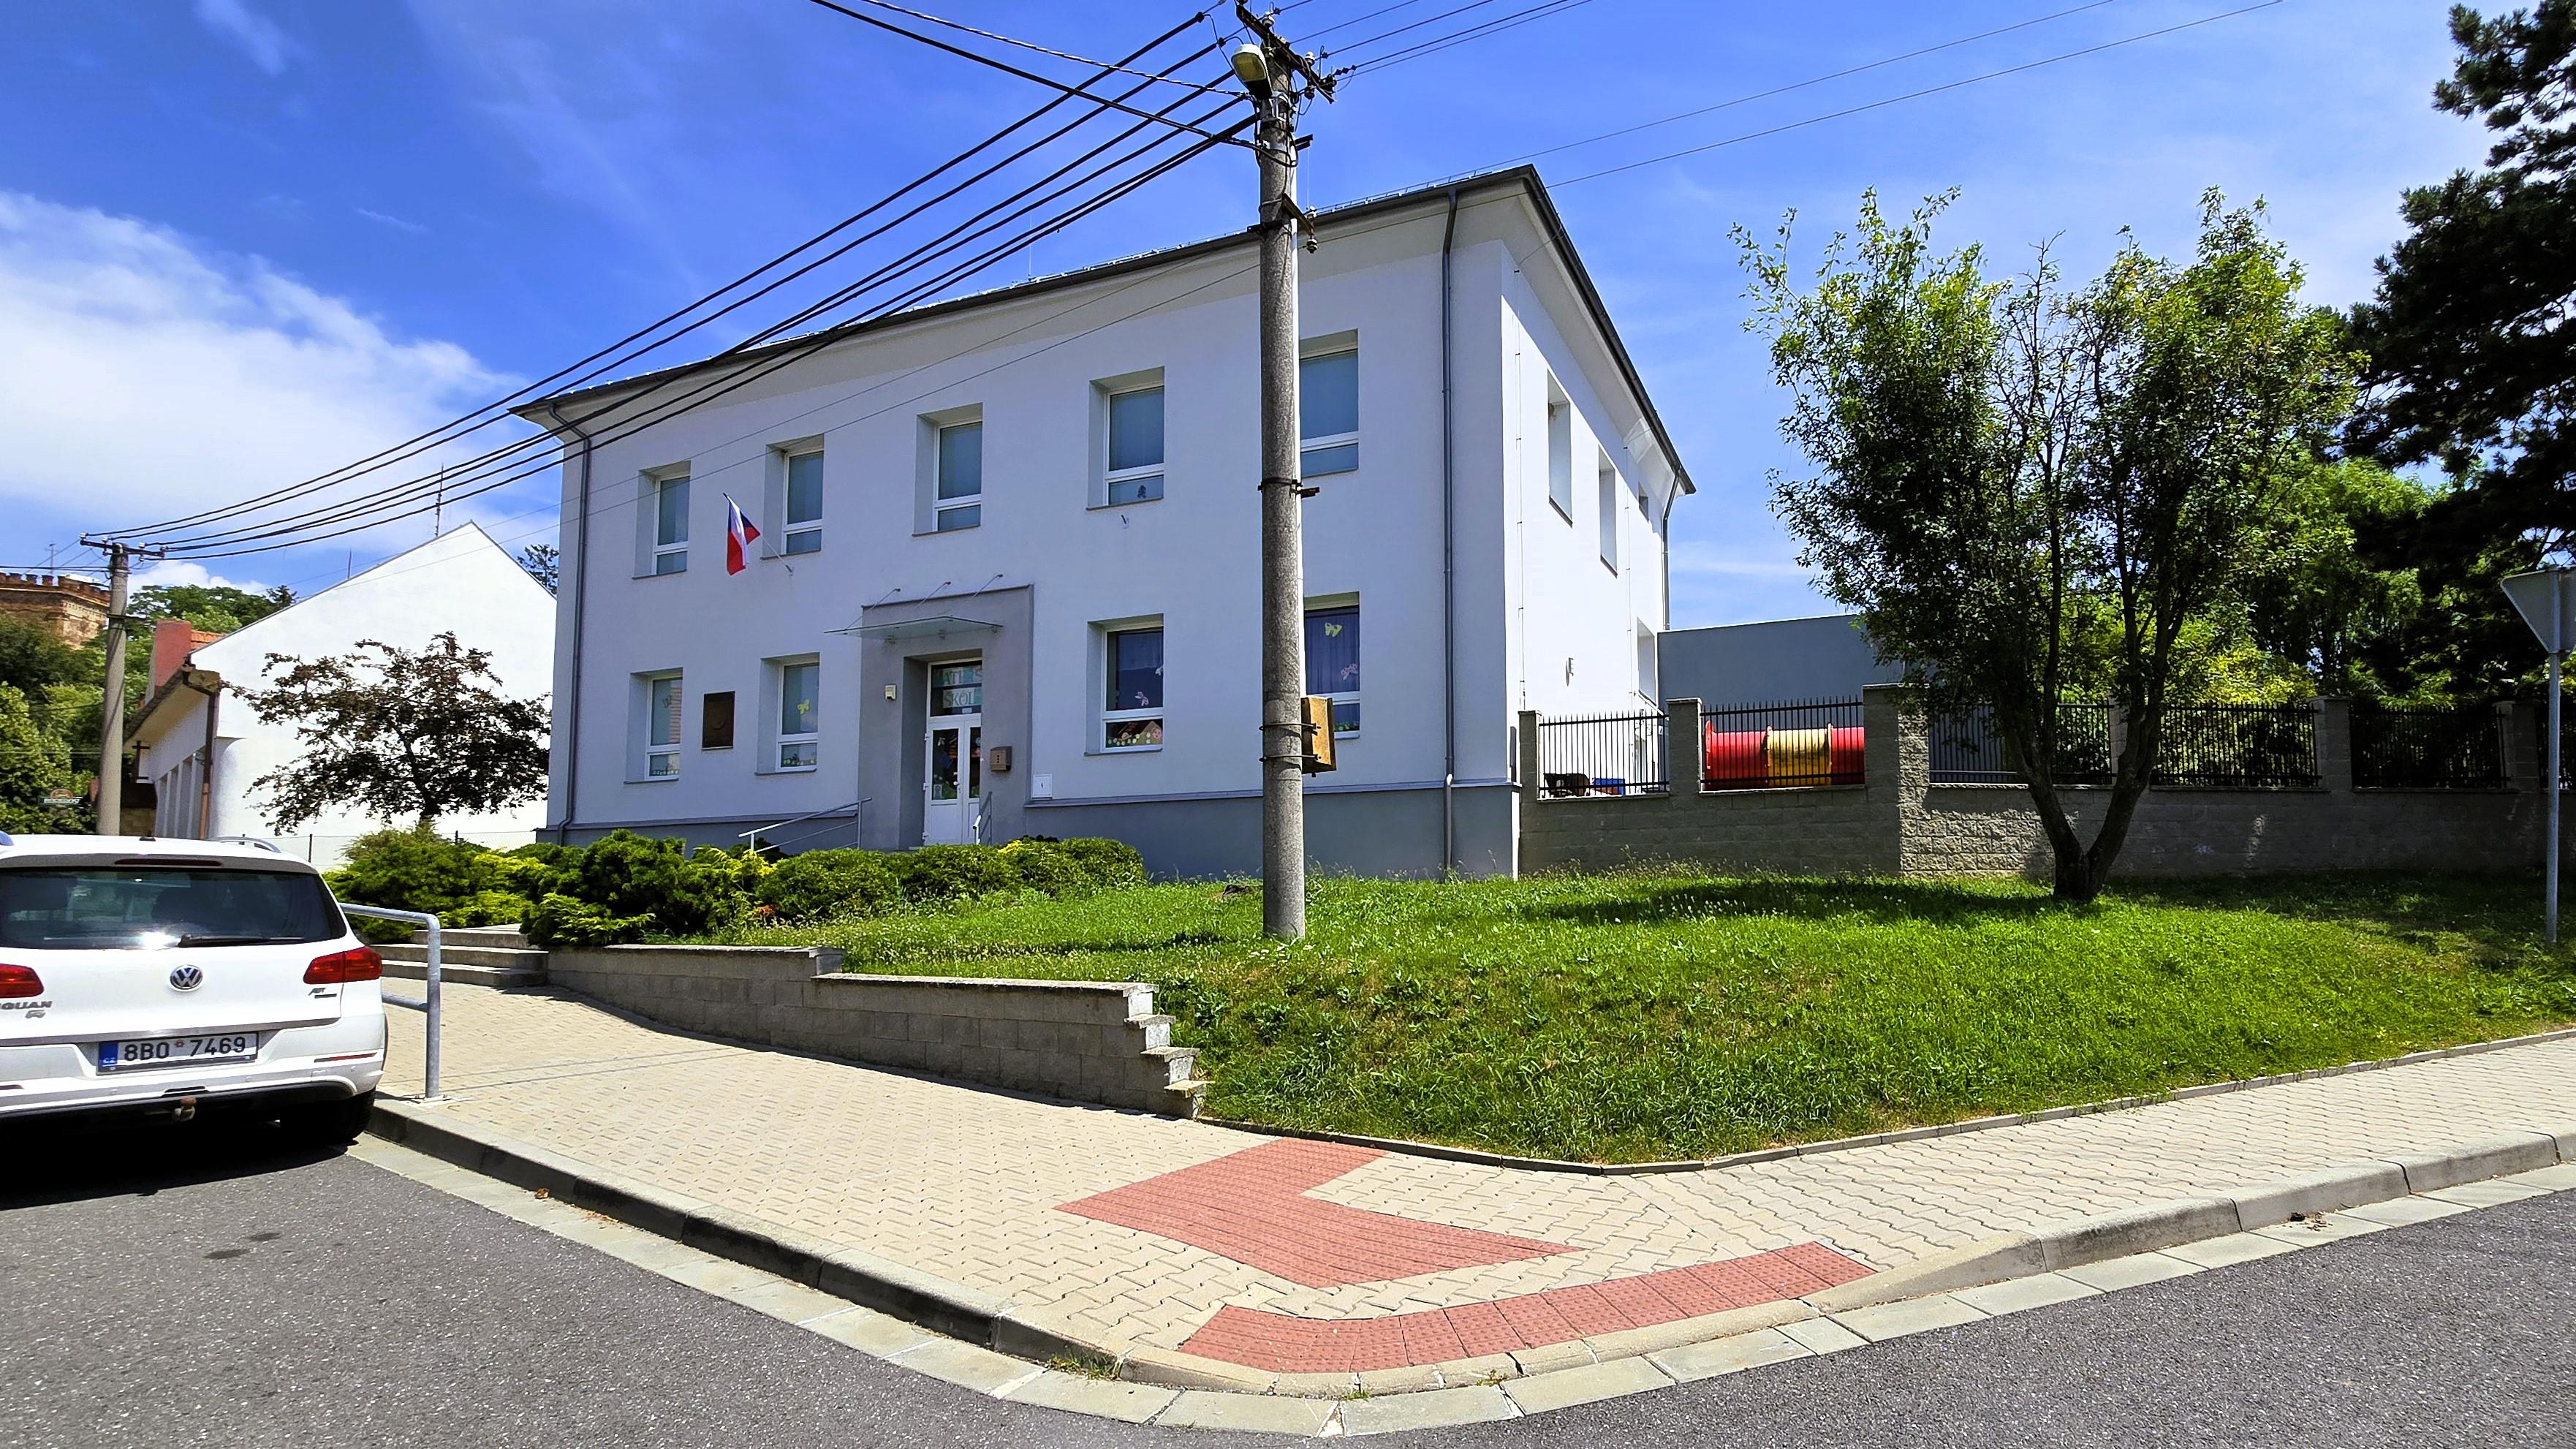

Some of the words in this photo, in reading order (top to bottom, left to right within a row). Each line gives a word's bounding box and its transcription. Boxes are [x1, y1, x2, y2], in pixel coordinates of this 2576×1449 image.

[0, 1001, 53, 1010] GUAN
[124, 1041, 170, 1062] 8B0
[189, 1036, 246, 1057] 7469
